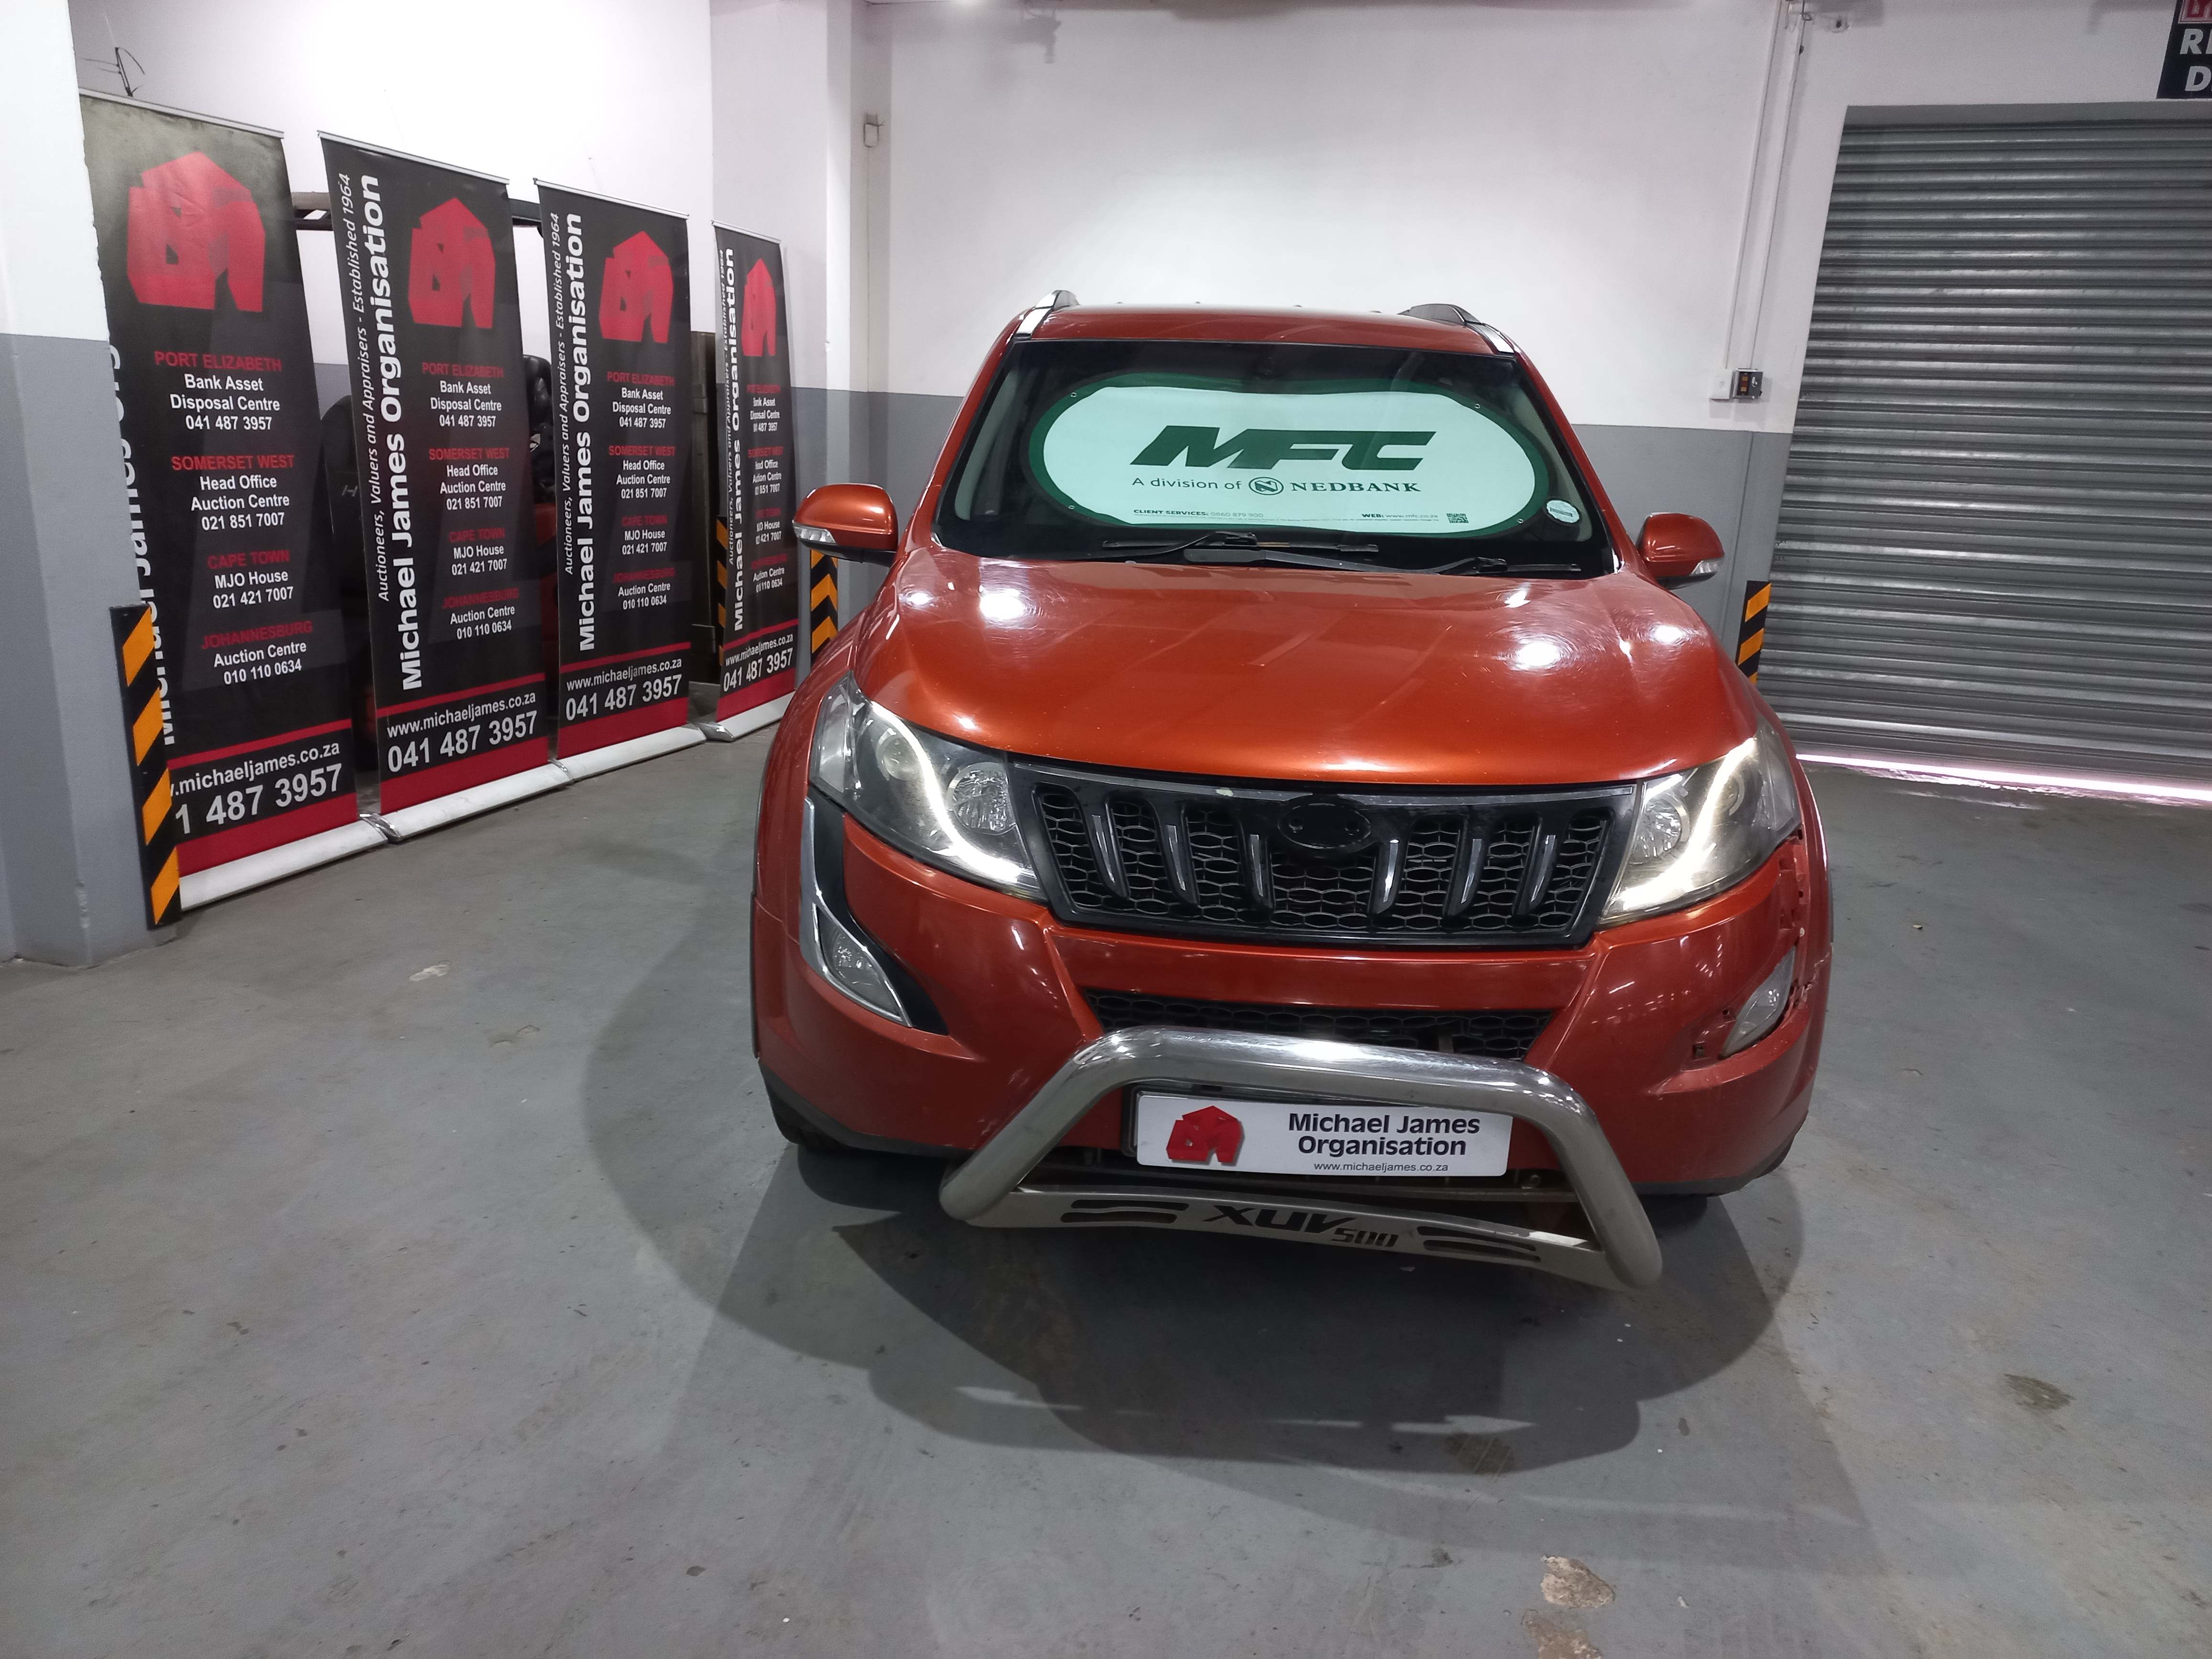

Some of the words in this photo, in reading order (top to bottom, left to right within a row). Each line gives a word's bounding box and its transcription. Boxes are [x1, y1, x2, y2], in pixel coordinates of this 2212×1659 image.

[338, 173, 354, 214] 1964
[551, 212, 560, 247] 1964
[346, 219, 364, 313] Established
[361, 175, 402, 422] Organisation
[552, 250, 564, 330] Established
[566, 213, 590, 422] Organisation
[155, 351, 198, 368] PORT
[203, 354, 282, 371] ELIZABETH
[358, 327, 375, 410] Appraisers
[185, 374, 221, 390] Bank
[226, 376, 263, 391] Asset
[556, 341, 569, 412] Appraisers
[440, 380, 464, 394] Bank
[466, 382, 491, 394] Asset
[621, 387, 640, 398] Bank
[641, 388, 664, 400] Asset
[170, 394, 233, 413] Disposal
[237, 396, 280, 411] Centre
[431, 398, 471, 412] Disposal
[474, 399, 502, 411] Centre
[612, 401, 645, 415] Disposal
[648, 403, 671, 414] Centre
[186, 415, 210, 430] 041
[215, 415, 238, 430] 487
[243, 416, 272, 430] 3957
[363, 413, 376, 444] and
[440, 415, 454, 426] 041
[458, 415, 474, 426] 487
[477, 416, 496, 427] 3957
[561, 413, 569, 440] and
[619, 417, 632, 427] 041
[634, 417, 647, 428] 487
[650, 418, 666, 429] 3957
[1130, 425, 1436, 470] MFC
[171, 455, 253, 471] SOMERSET
[256, 454, 294, 468] WEST
[447, 465, 469, 477] Head
[473, 464, 498, 476] Office
[562, 443, 571, 492] Valuers
[623, 460, 641, 470] Head
[643, 460, 665, 470] Office
[200, 476, 235, 490] Head
[239, 475, 277, 489] Office
[368, 448, 381, 504] Valuers
[577, 431, 593, 529] James
[616, 475, 645, 485] Auction
[647, 474, 671, 484] Centre
[1150, 478, 1218, 488] division
[1224, 481, 1241, 489] of
[1290, 483, 1421, 492] NEDBANK
[387, 433, 412, 547] James
[440, 482, 476, 494] Auction
[478, 481, 506, 492] Centre
[621, 488, 634, 499] 021
[635, 488, 648, 498] 851
[650, 487, 667, 498] 7007
[191, 496, 245, 511] Auction
[249, 494, 290, 508] Centre
[446, 498, 461, 510] 021
[465, 498, 480, 509] 851
[483, 496, 502, 508] 7007
[201, 516, 225, 531] 021
[230, 514, 252, 529] 851
[256, 512, 285, 526] 7007
[564, 497, 573, 575] Auctioneers,
[624, 530, 640, 541] MJO
[642, 530, 665, 540] House
[375, 510, 389, 601] Auctioneers,
[453, 546, 473, 559] MJO
[476, 545, 504, 556] House
[622, 544, 634, 555] 021
[636, 543, 649, 553] 421
[651, 542, 667, 552] 7007
[452, 563, 466, 575] 021
[470, 561, 485, 573] 421
[488, 558, 507, 570] 7007
[214, 573, 245, 589] MJO
[249, 571, 288, 586] House
[618, 585, 646, 597] Auction
[648, 582, 671, 593] Centre
[213, 593, 236, 608] 021
[240, 590, 262, 605] 421
[265, 586, 294, 602] 7007
[577, 538, 595, 652] Michael
[623, 599, 635, 610] 010
[637, 597, 649, 608] 110
[651, 595, 667, 606] 0634
[393, 558, 422, 690] Michael
[450, 610, 485, 624] Auction
[487, 606, 515, 618] Centre
[457, 627, 472, 639] 010
[475, 623, 489, 636] 110
[492, 619, 512, 632] 0634
[213, 649, 264, 667] Auction
[268, 641, 307, 657] Centre
[223, 670, 246, 685] 010
[251, 664, 271, 681] 110
[274, 658, 302, 675] 0634
[566, 658, 682, 691] www.michaeljames.co.za
[723, 667, 742, 692] 041
[746, 657, 763, 682] 487
[767, 648, 793, 673] 3957
[566, 692, 597, 721] 041
[604, 684, 637, 710] 487
[642, 674, 682, 702] 3957
[387, 693, 535, 738] www.michaeljames.co.za
[388, 738, 429, 773] 041
[440, 725, 480, 757] 487
[489, 710, 537, 745] 3957
[170, 742, 340, 797] .michaeljames.co.za
[206, 785, 263, 825] 487
[275, 763, 342, 807] 3957
[1288, 1113, 1389, 1134] Michael
[1396, 1115, 1480, 1134] James
[1298, 1135, 1467, 1157] Organisation
[1314, 1162, 1449, 1173] www.michaeljames.co.za
